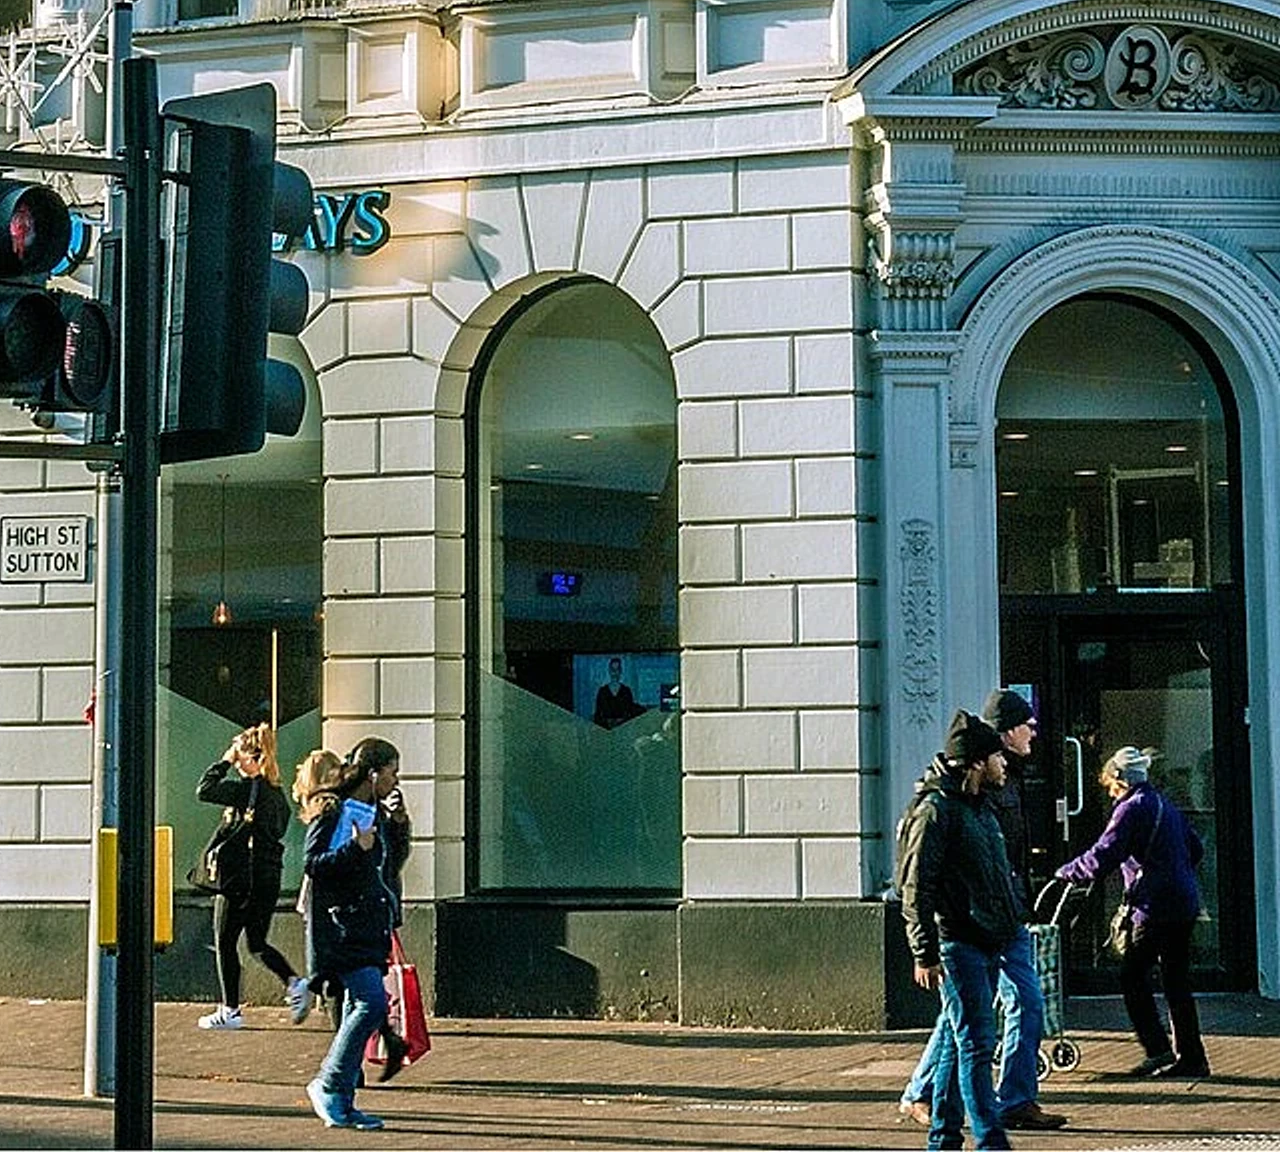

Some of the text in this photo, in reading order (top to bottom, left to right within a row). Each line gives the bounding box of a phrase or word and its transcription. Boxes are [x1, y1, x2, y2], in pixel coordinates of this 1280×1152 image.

[5, 525, 80, 547] HIGH ST.
[5, 551, 80, 573] SUTTON
